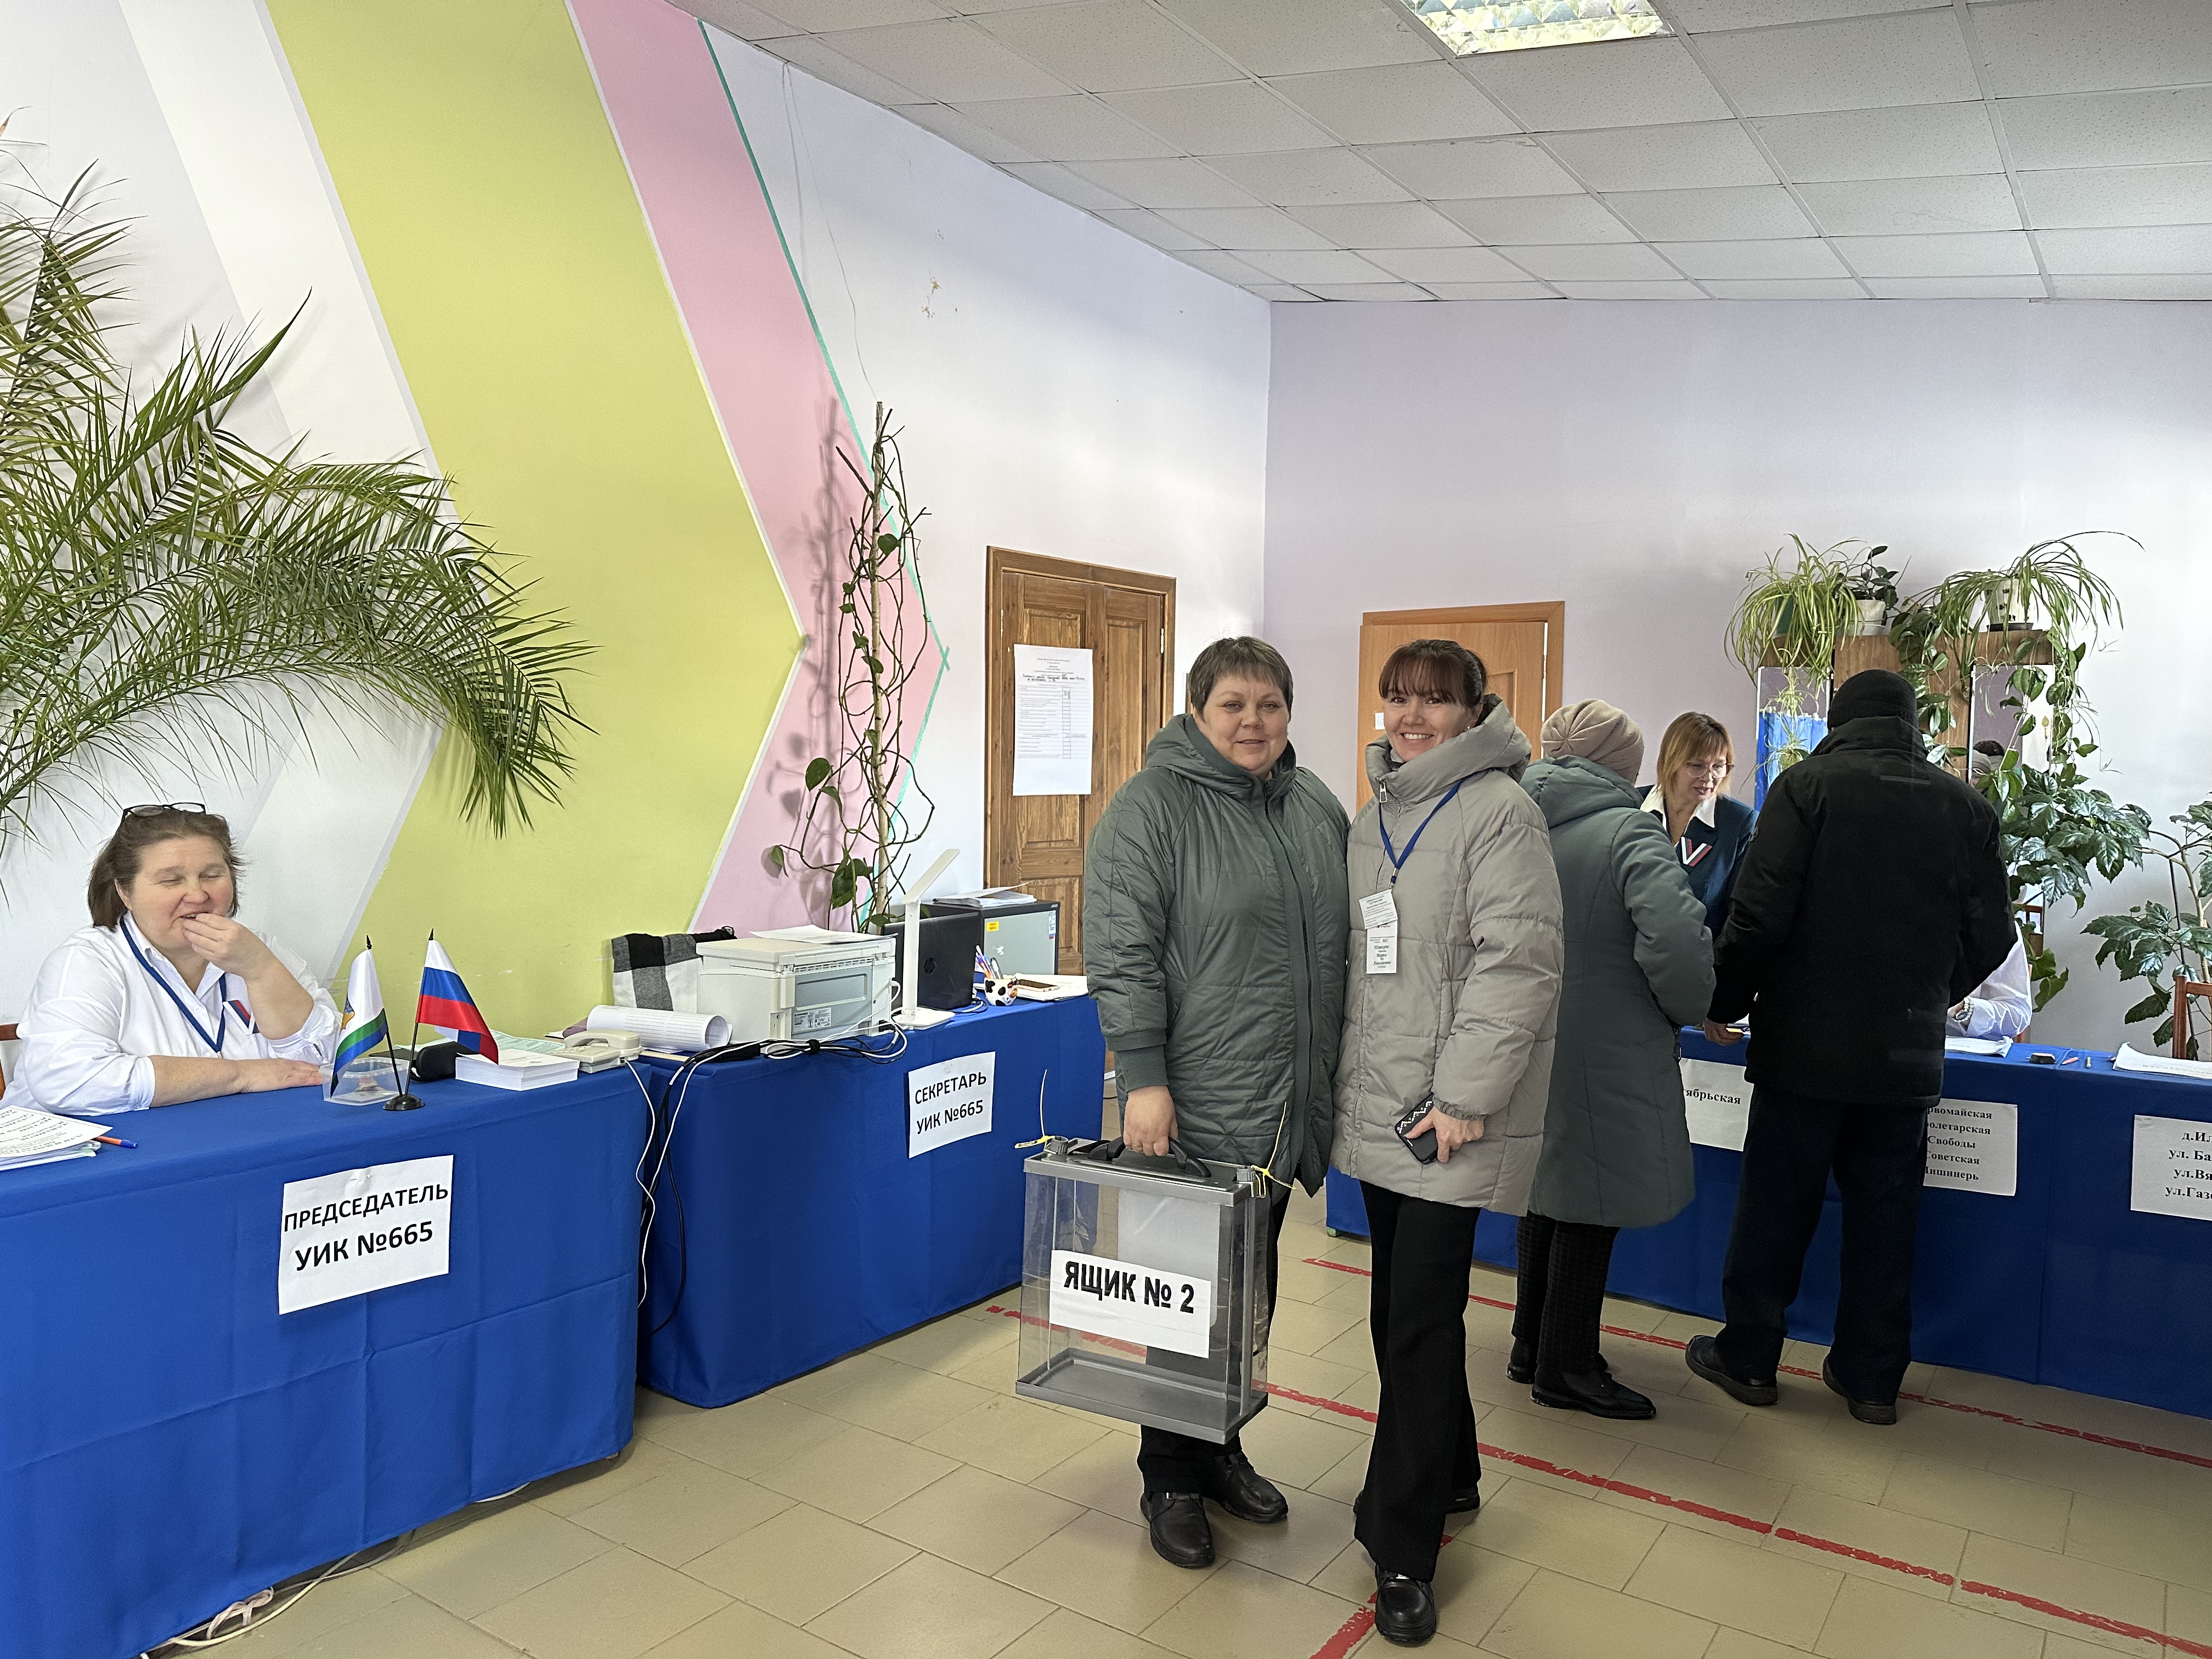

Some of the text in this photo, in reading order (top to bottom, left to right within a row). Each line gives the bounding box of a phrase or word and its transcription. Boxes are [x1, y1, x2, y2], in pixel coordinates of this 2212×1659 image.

[915, 1072, 987, 1104] СЕКРЕТАРЬ
[1684, 1089, 1741, 1105] ябрьская
[917, 1099, 983, 1135] УИК №665
[1927, 1122, 1990, 1135] олетарская
[1927, 1135, 1976, 1148] Свободы
[2169, 1149, 2211, 1161] ул. Ба
[2174, 1169, 2212, 1181] ул.Вя
[284, 1184, 448, 1233] ПРЕДСЕДАТЕЛЬ
[295, 1221, 433, 1271] УИК №665
[1064, 1261, 1194, 1314] ЯЩИК № 2
